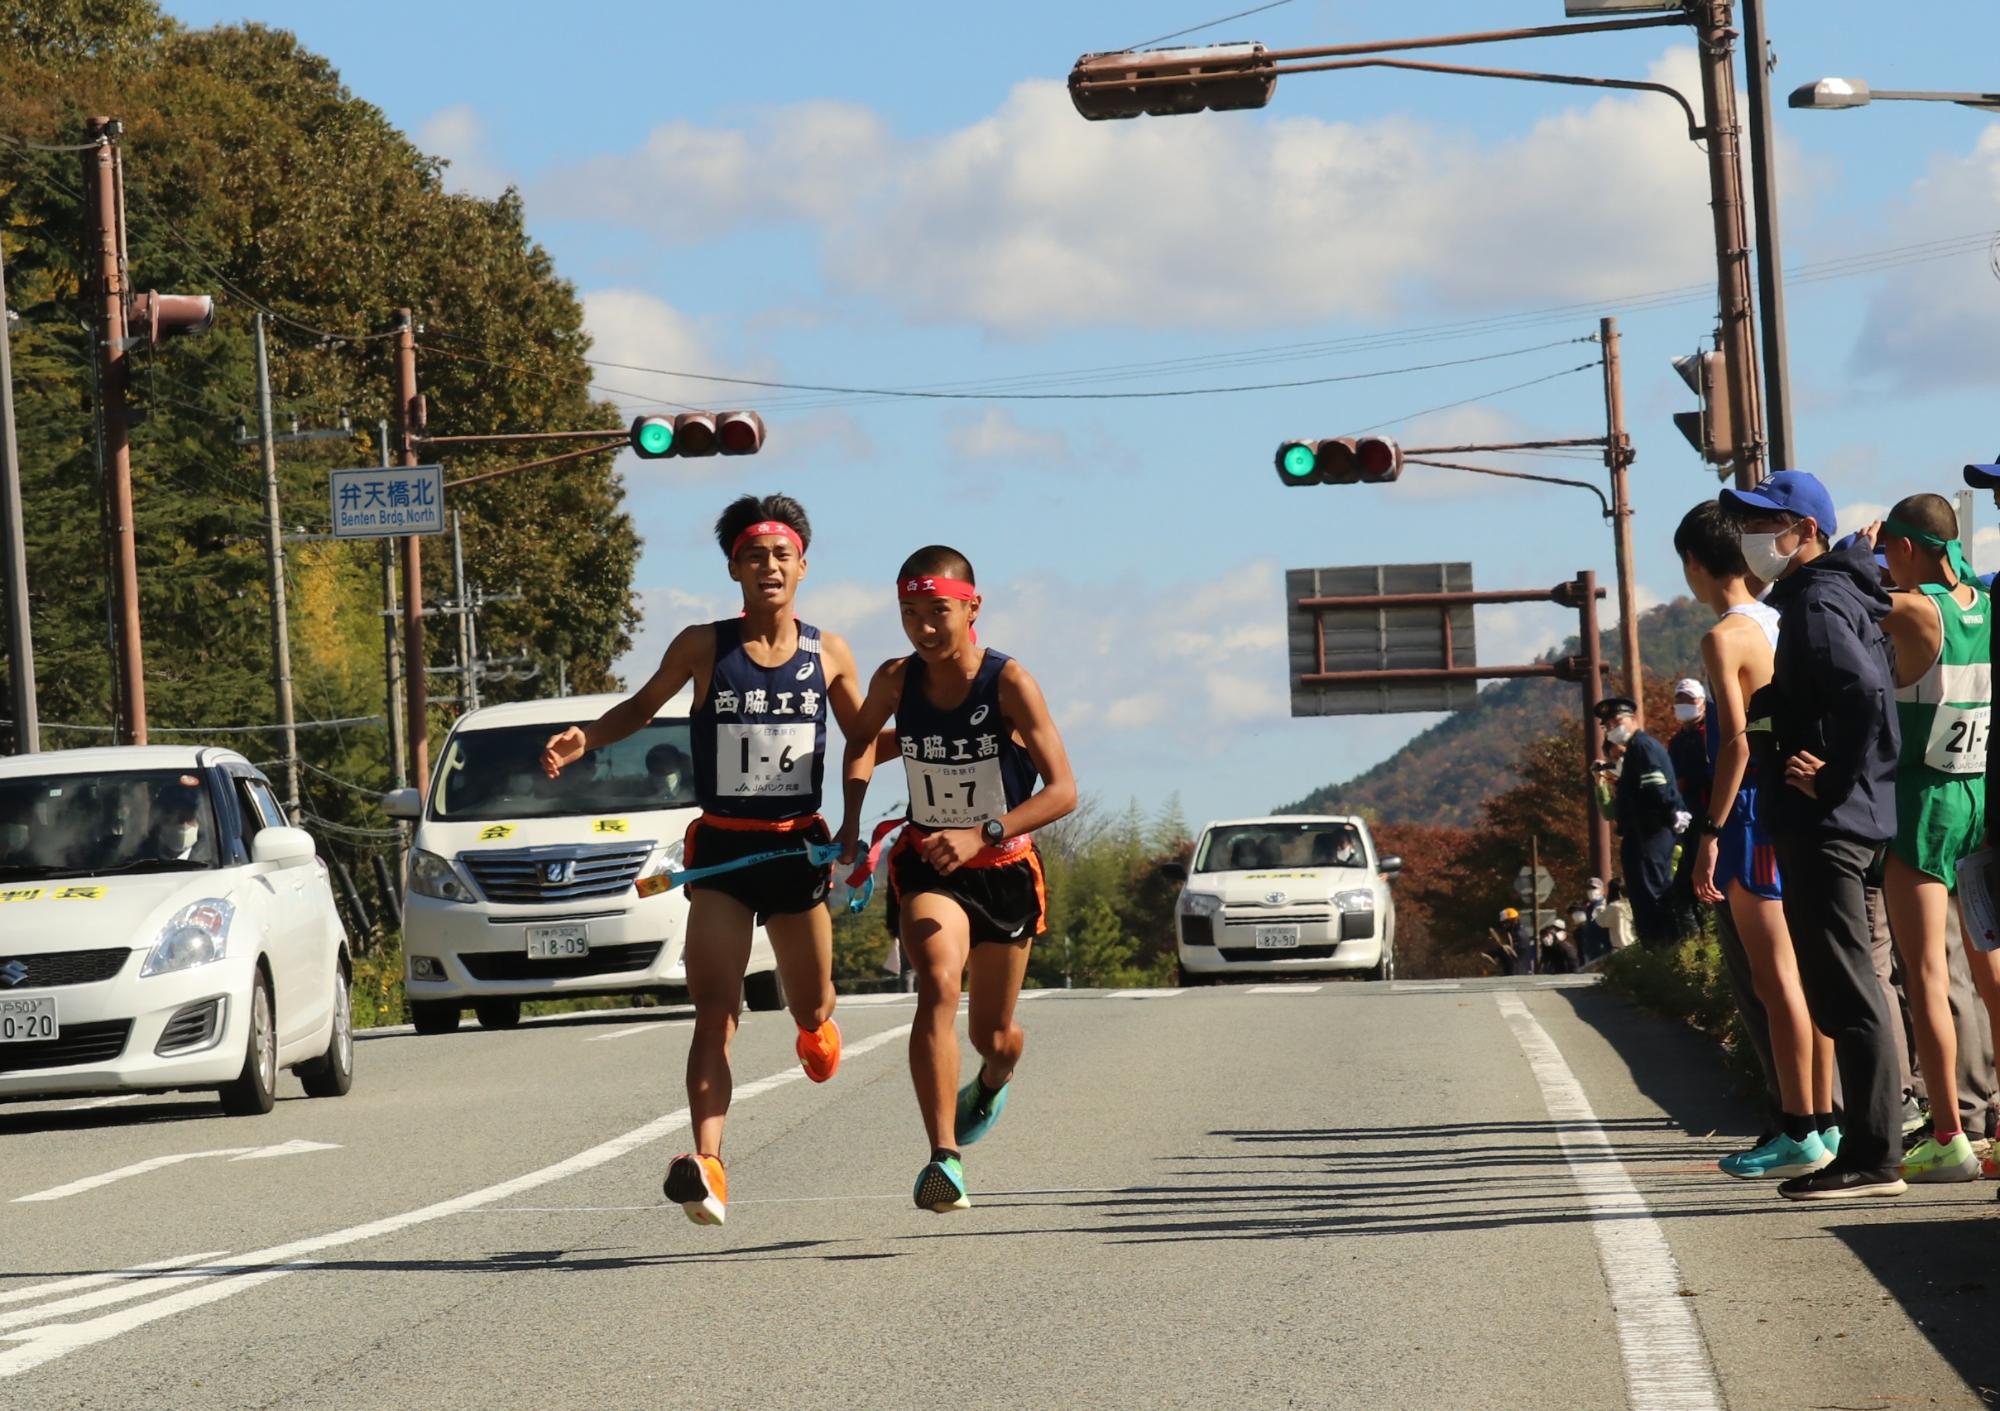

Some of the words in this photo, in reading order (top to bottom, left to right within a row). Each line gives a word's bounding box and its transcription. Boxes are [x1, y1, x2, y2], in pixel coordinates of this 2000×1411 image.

[339, 478, 434, 510] 弁天橋北
[341, 511, 376, 526] Benten
[407, 507, 435, 522] North
[907, 579, 936, 591] 西工
[741, 737, 795, 773] 1-6
[924, 774, 976, 808] 1-7
[542, 937, 585, 955] 18-09
[0, 1001, 37, 1014] 戸503
[4, 1015, 52, 1039] 0-20
